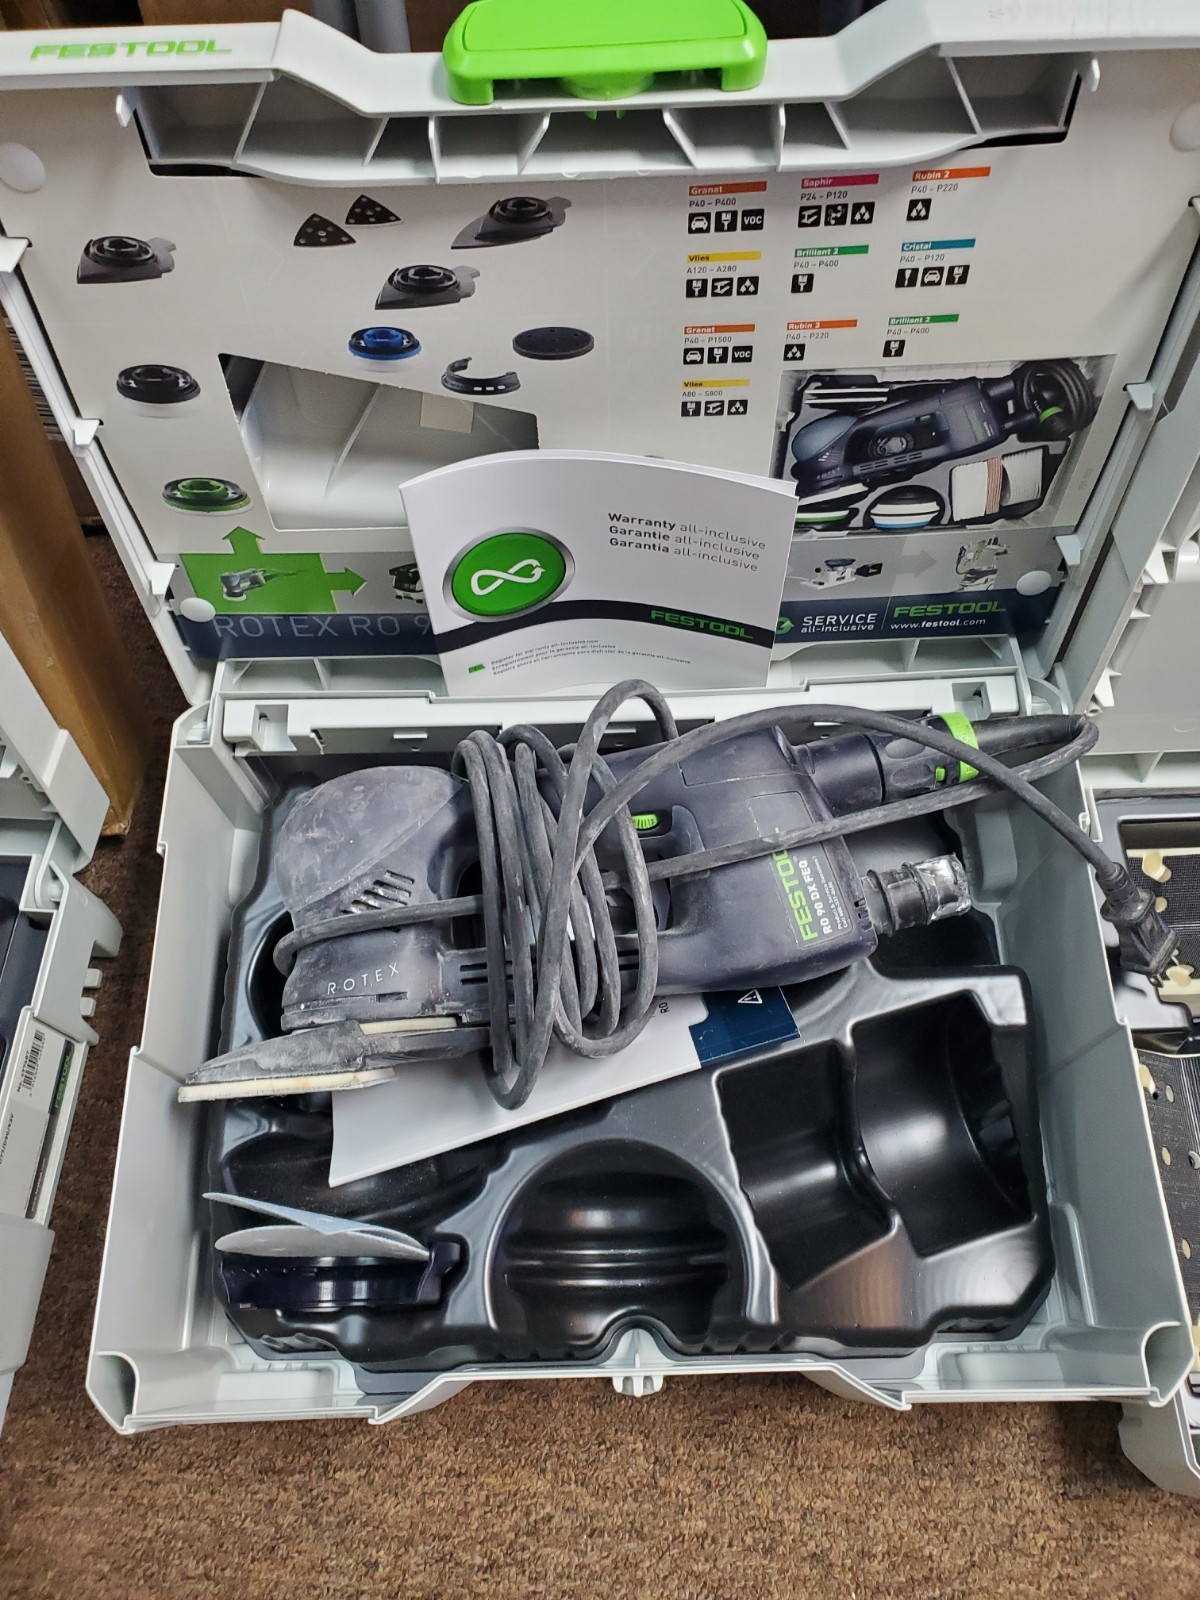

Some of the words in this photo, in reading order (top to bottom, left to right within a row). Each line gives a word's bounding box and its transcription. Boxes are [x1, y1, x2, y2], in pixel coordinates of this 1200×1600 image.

[30, 39, 232, 61] FESTOOL
[915, 171, 941, 180] Rubin
[943, 170, 950, 179] 2
[803, 178, 833, 188] Saphir
[911, 185, 927, 194] P40
[936, 183, 958, 192] P220
[691, 185, 723, 195] Granat
[800, 193, 817, 201] P24
[826, 190, 848, 200] P120
[689, 200, 705, 208] P40
[715, 198, 736, 207] P400
[743, 216, 762, 225] VOC
[903, 242, 932, 251] Cristal
[796, 248, 831, 257] Brilliant
[900, 255, 915, 263] P40
[924, 253, 945, 262] P120
[716, 265, 737, 273] A280
[793, 261, 809, 269] P40
[818, 260, 839, 268] P400
[788, 322, 813, 330] Rubin
[890, 317, 923, 325] Brilliant
[686, 326, 716, 334] Granat
[910, 327, 930, 335] P400
[708, 336, 732, 344] P1500
[786, 333, 800, 341] P40
[809, 332, 829, 340] P220
[734, 350, 751, 358] VOC
[608, 512, 676, 531] Warranty
[680, 523, 766, 550] all-inclusive
[609, 525, 671, 541] Garantie
[674, 535, 760, 560] all-inclusive
[674, 546, 758, 572] all-inclusive
[893, 601, 1006, 618] FESTOOL
[651, 610, 753, 639] FESTOOL
[802, 613, 878, 626] SERVICE
[890, 617, 986, 630] www.festool.com
[212, 615, 339, 638] ROTEX
[350, 615, 400, 637] RO
[801, 623, 874, 634] all-inclusive
[806, 883, 820, 901] DX
[814, 901, 826, 917] 90
[819, 917, 833, 935] RO
[327, 962, 400, 995] ROTEX
[659, 1002, 670, 1014] RO
[53, 1054, 73, 1109] FESTOOL
